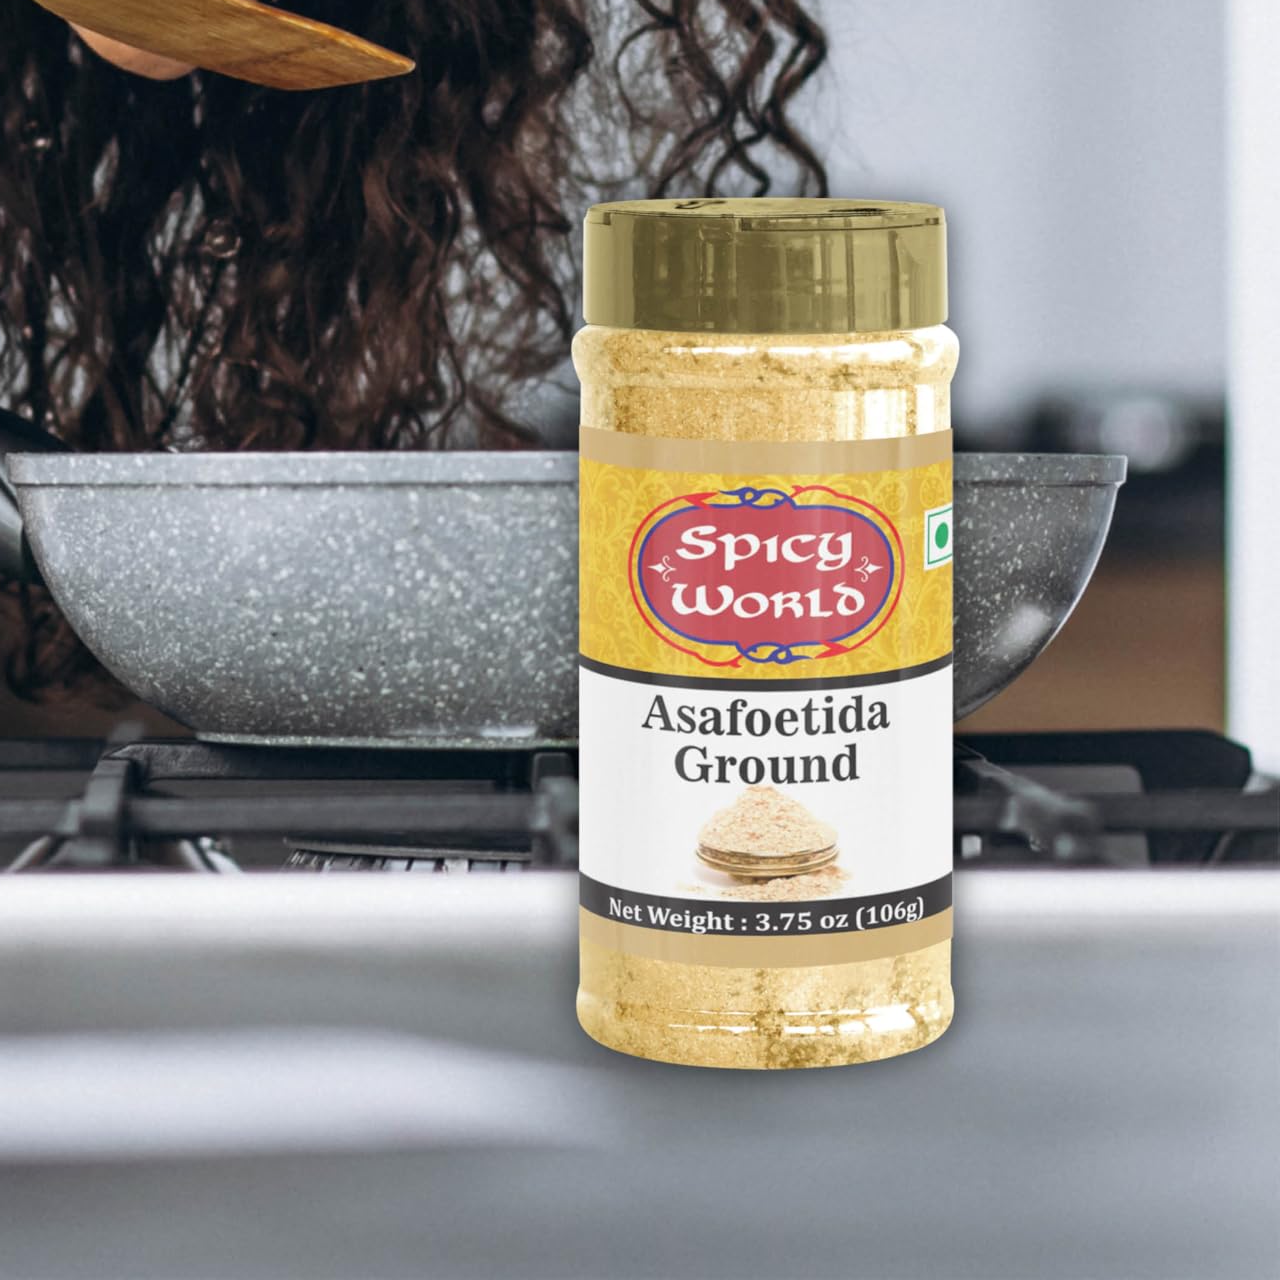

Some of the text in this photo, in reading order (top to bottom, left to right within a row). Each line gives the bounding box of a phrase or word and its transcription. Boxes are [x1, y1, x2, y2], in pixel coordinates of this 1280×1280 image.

[675, 525, 853, 571] Spicy
[641, 694, 891, 737] Asafoetida
[674, 743, 861, 785] Ground
[609, 897, 643, 922] Net
[648, 906, 734, 934] Weight
[755, 911, 813, 931] 3.75
[821, 915, 849, 928] oz
[855, 897, 925, 931] (106g)
